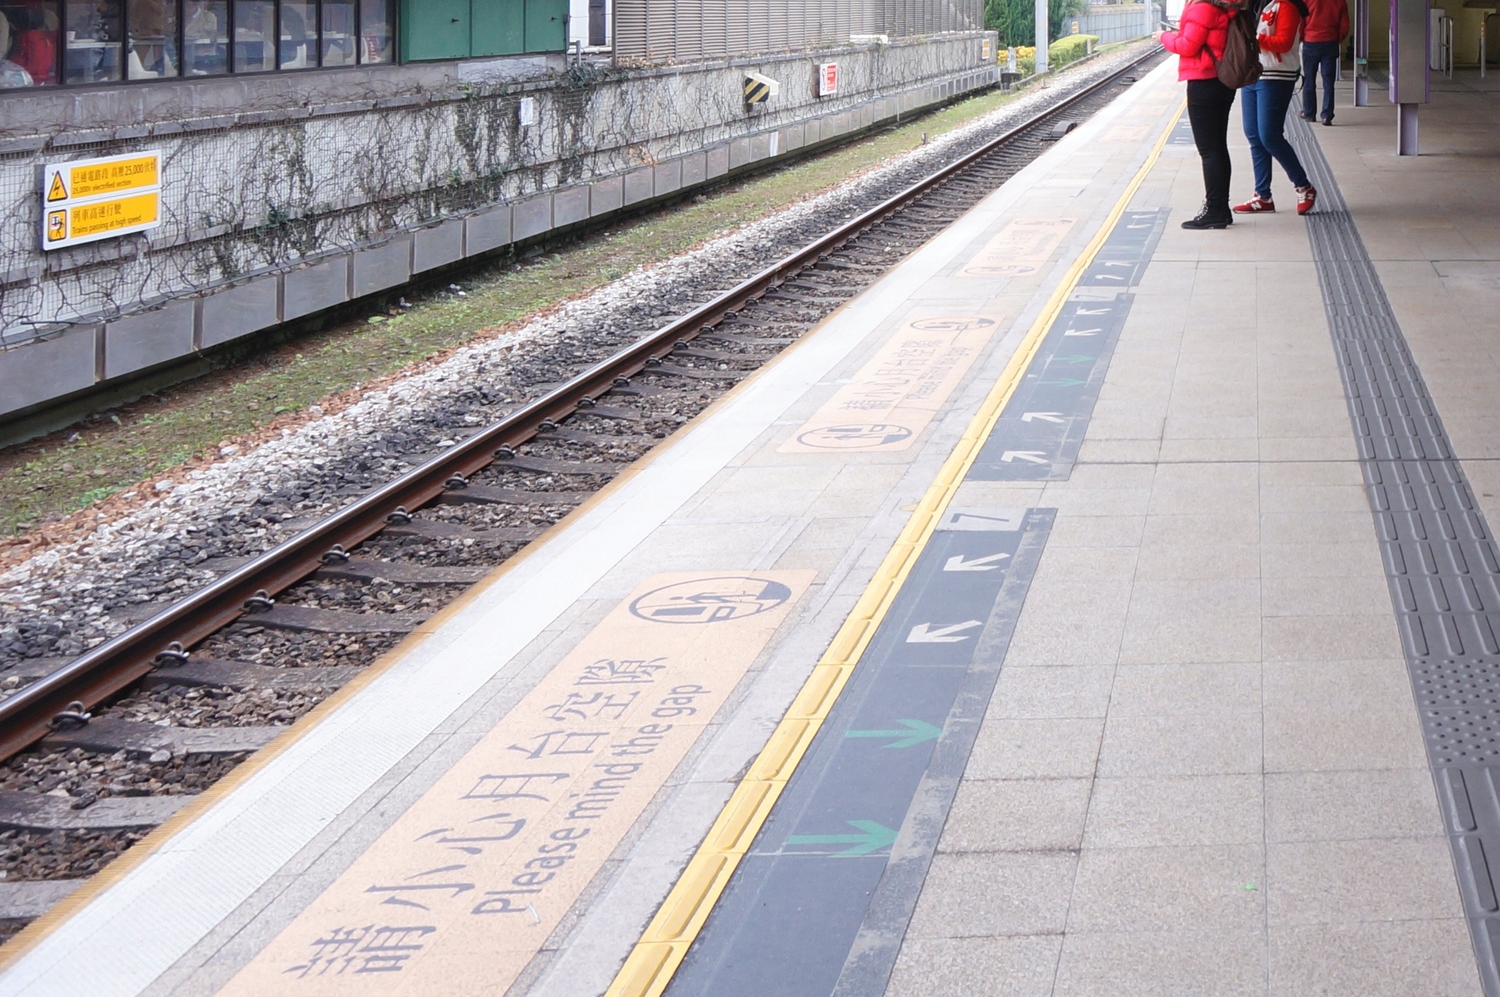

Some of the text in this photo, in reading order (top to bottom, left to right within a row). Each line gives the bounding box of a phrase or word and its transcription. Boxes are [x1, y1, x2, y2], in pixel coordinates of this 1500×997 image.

[281, 656, 669, 979] 請小心月台空隙
[470, 683, 712, 916] Please mind the gap
